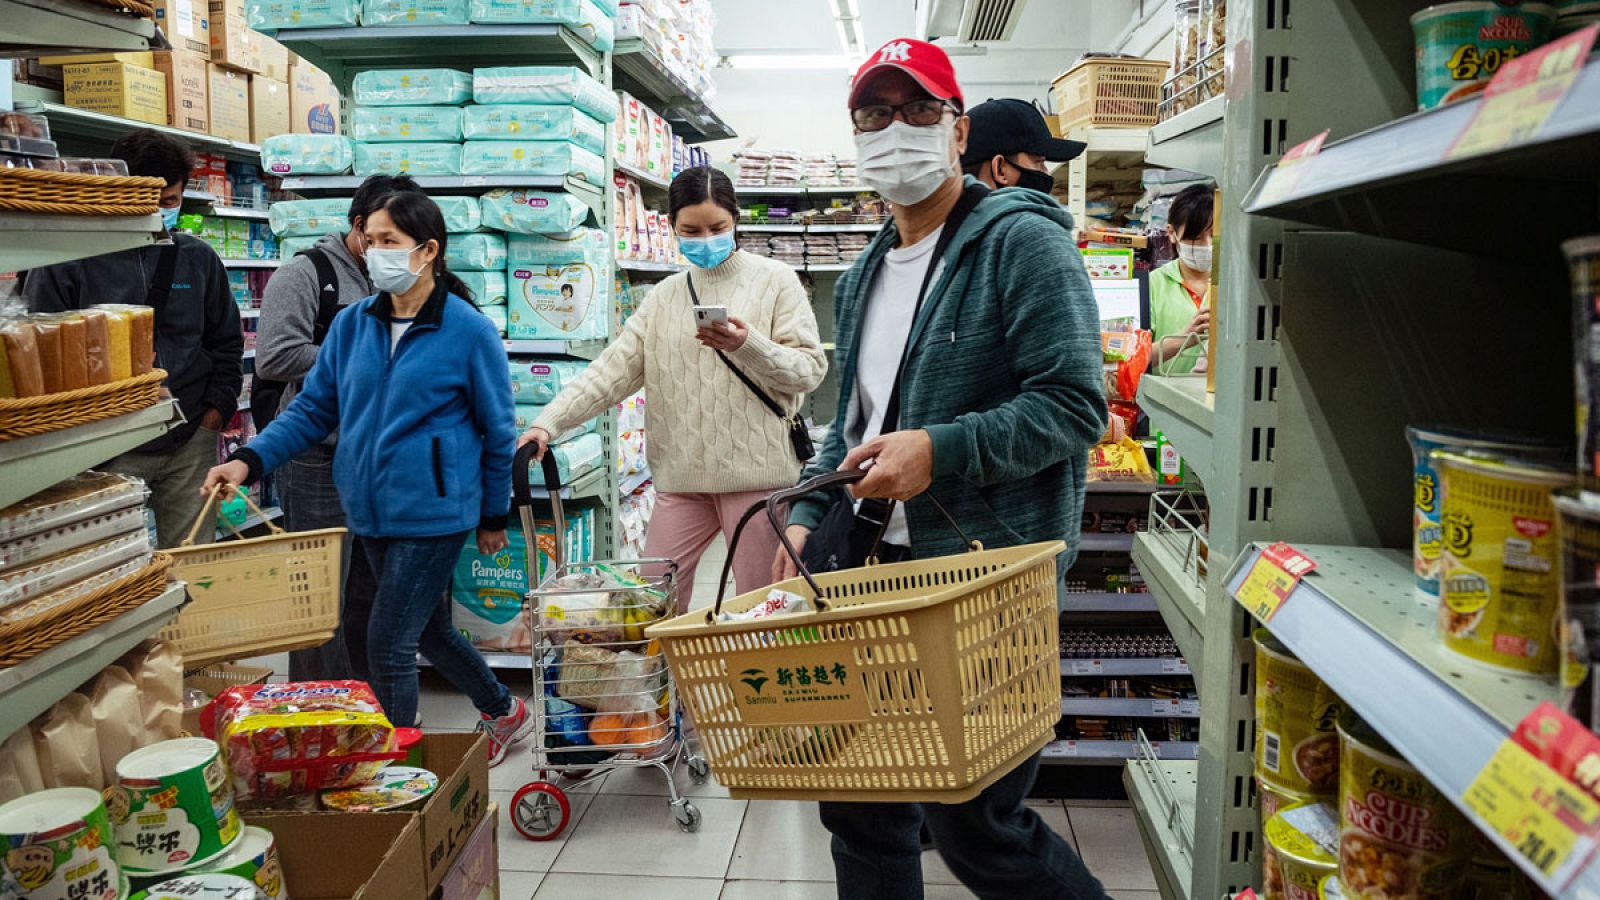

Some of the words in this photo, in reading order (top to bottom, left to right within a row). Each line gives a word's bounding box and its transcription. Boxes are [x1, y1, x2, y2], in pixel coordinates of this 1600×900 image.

[471, 559, 524, 581] Pampers
[776, 662, 847, 688] 新苗超市
[784, 694, 851, 703] SUPERMARKET
[1366, 790, 1431, 824] CUP
[1344, 798, 1448, 851] NOODLES
[155, 879, 253, 900] 出前一丁
